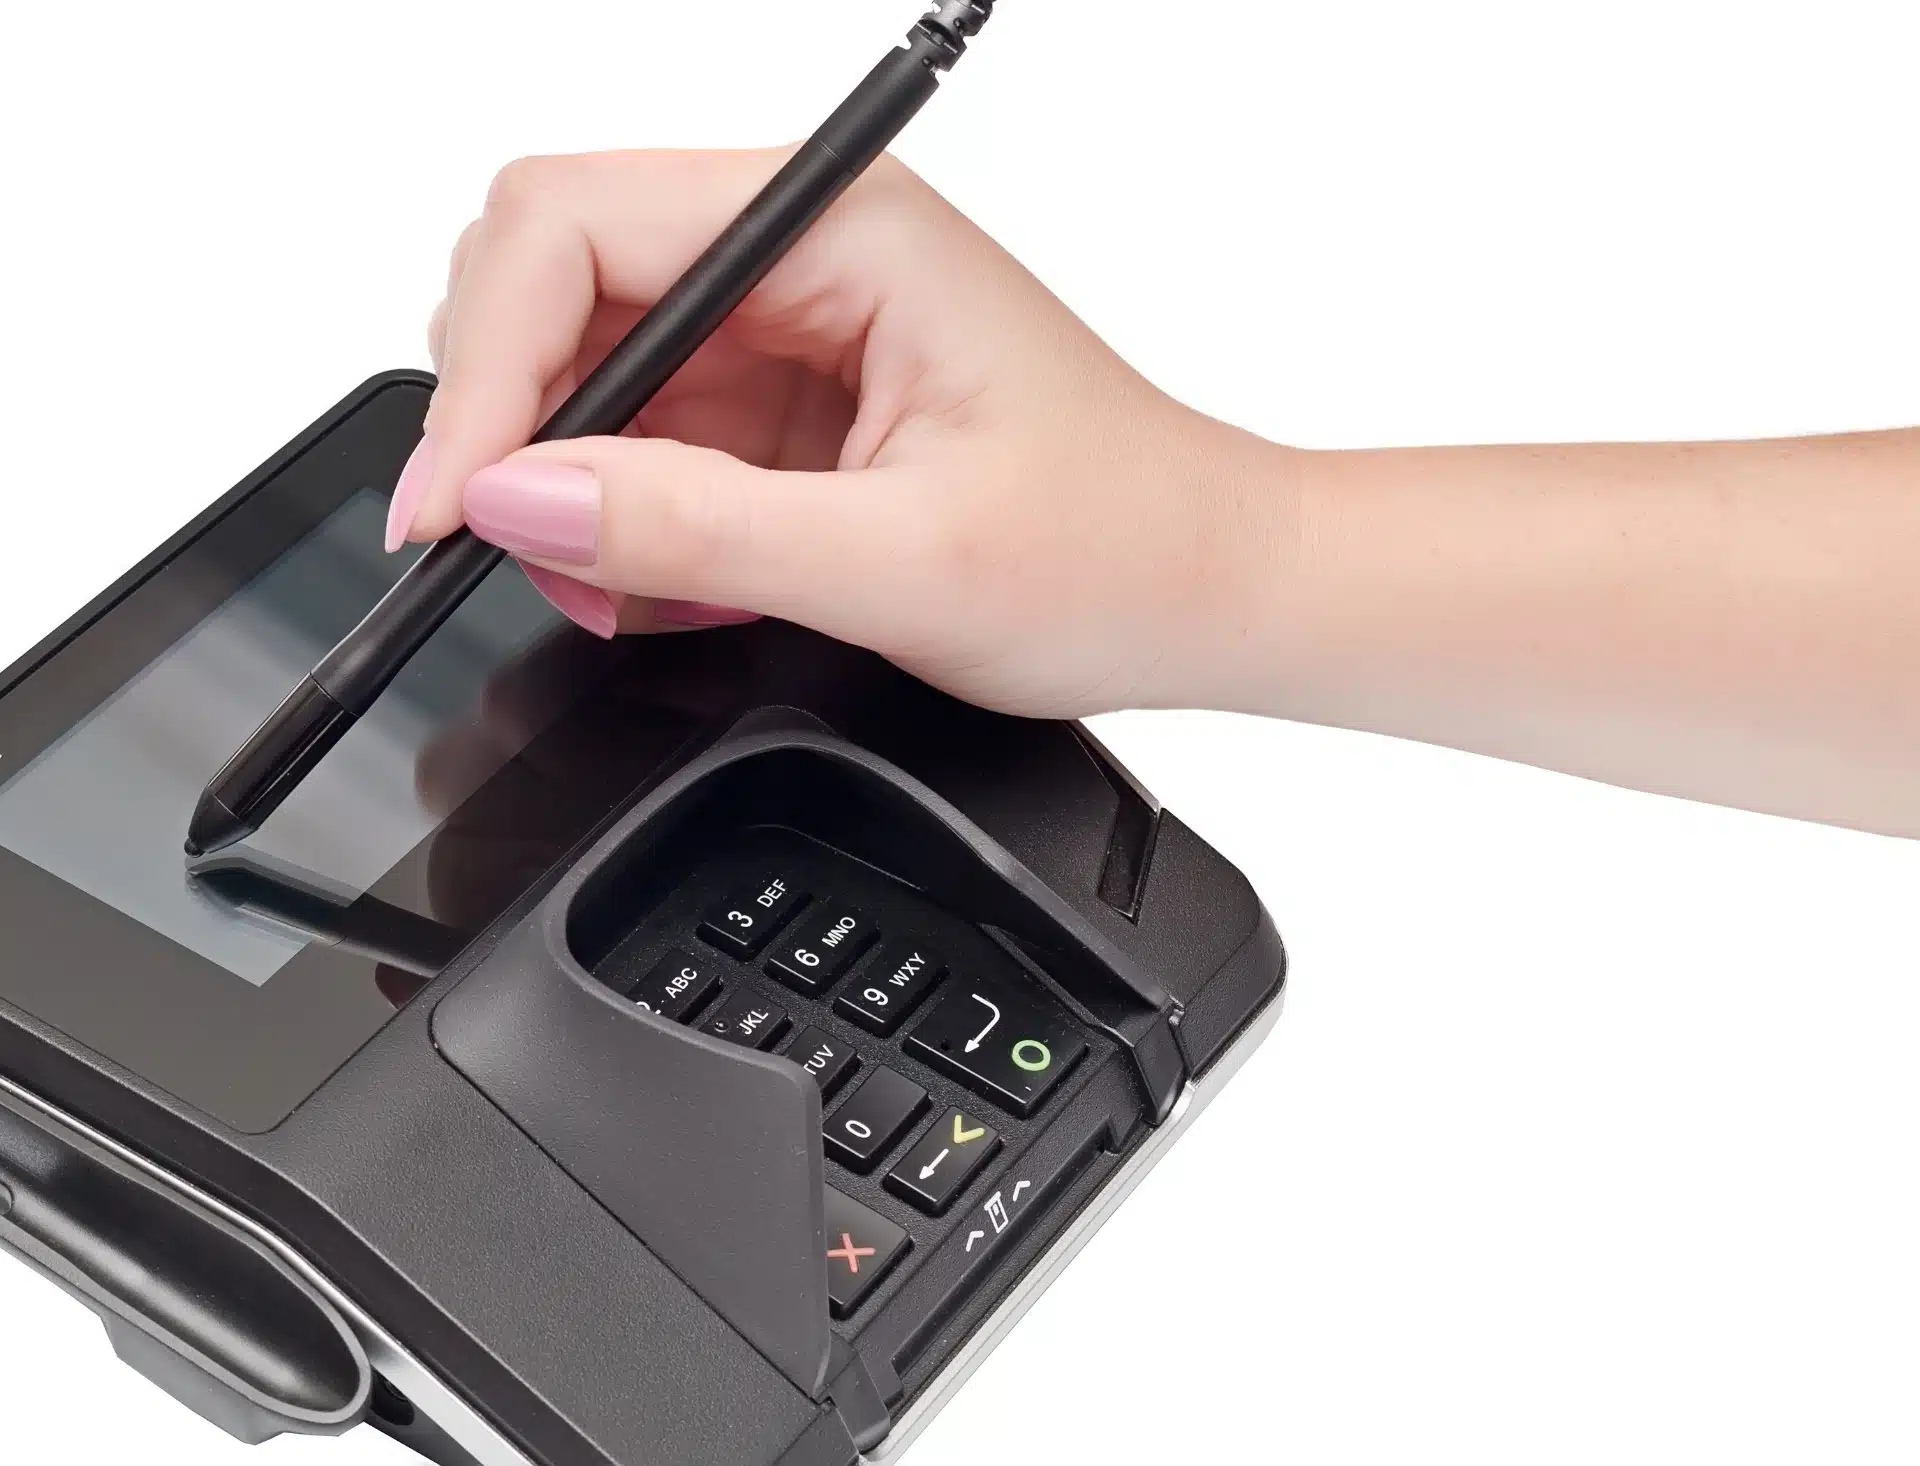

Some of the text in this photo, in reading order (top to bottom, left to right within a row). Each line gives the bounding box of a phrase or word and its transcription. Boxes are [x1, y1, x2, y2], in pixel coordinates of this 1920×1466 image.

[728, 879, 786, 927] 3 DEF
[794, 916, 856, 966] 6 MNO
[665, 967, 698, 999] ABC
[863, 952, 926, 1006] 9 WXY
[738, 1010, 769, 1035] JKL
[844, 1119, 872, 1139] 0
